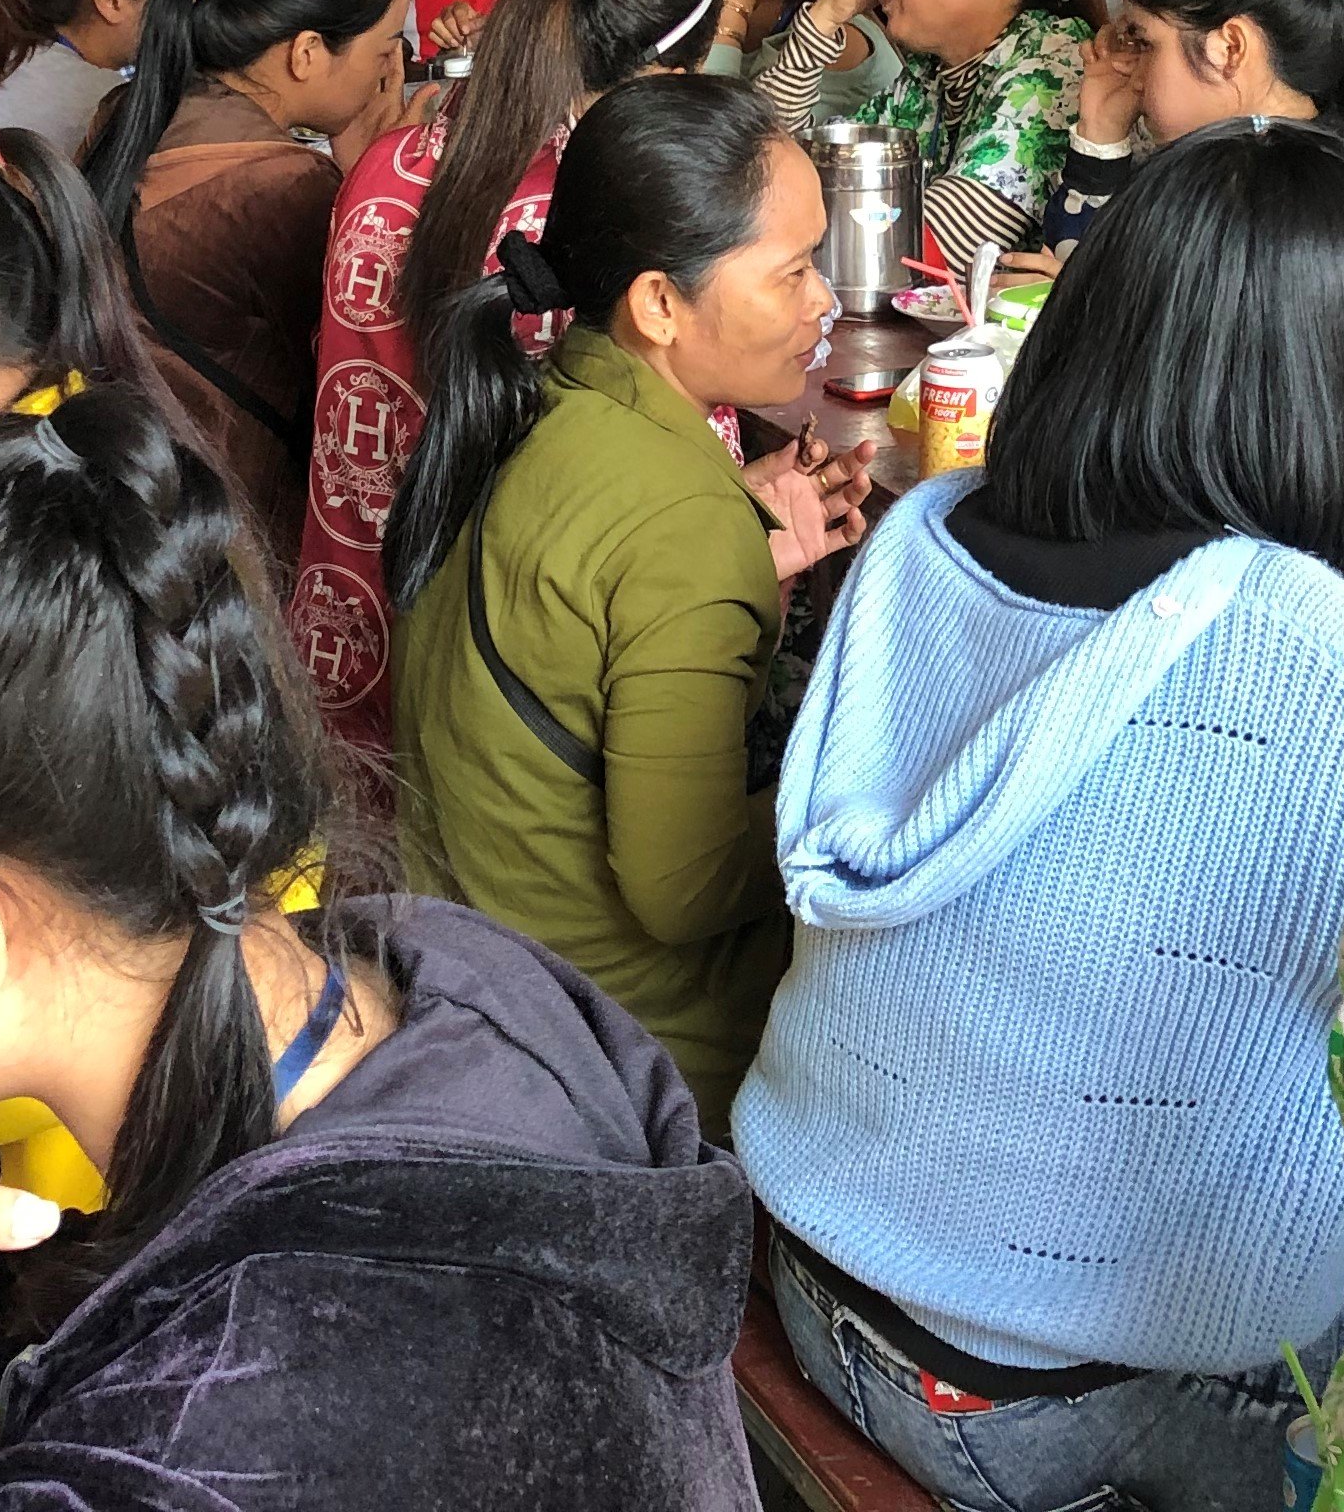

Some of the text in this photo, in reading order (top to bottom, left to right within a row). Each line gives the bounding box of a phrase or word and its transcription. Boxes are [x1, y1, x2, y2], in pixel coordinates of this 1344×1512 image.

[345, 257, 387, 306] H
[923, 387, 973, 406] FRESHY
[344, 395, 390, 461] H
[307, 630, 346, 681] H
